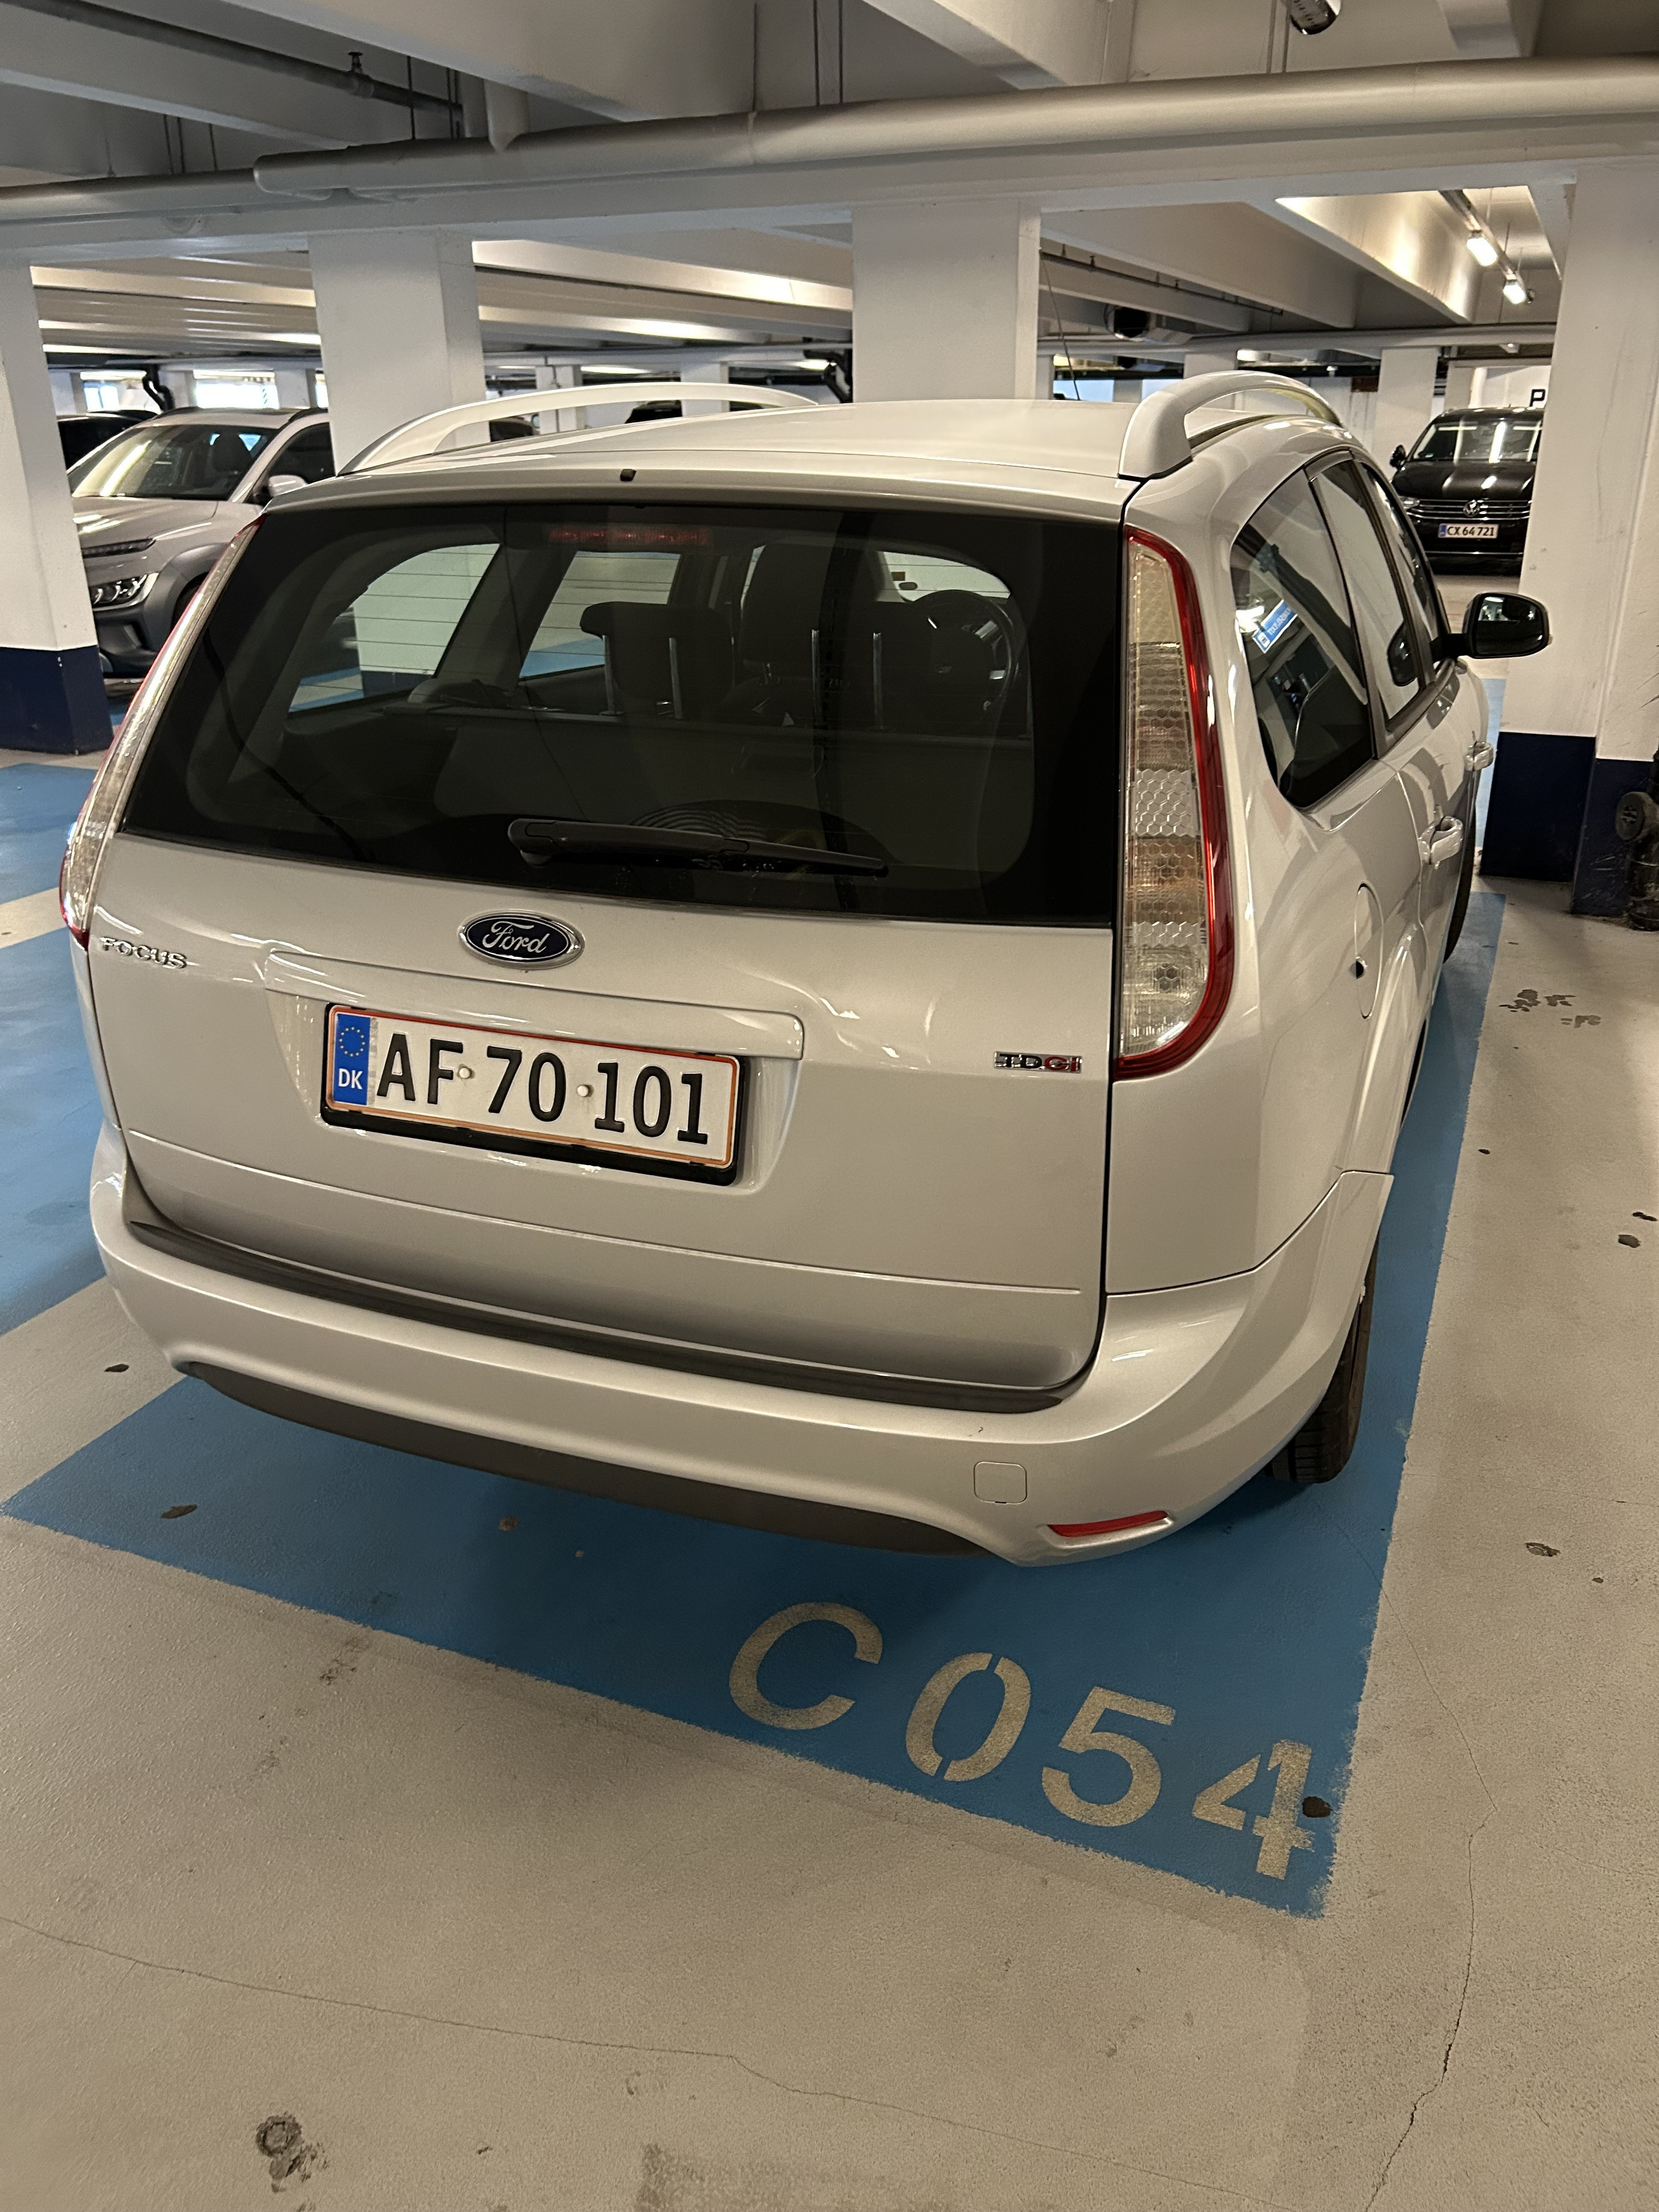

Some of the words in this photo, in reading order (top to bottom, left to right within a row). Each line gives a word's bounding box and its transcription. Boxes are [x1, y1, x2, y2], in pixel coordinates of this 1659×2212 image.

[1447, 526, 1460, 536] CX
[1463, 527, 1475, 536] 64
[1477, 527, 1494, 536] 721
[99, 935, 188, 969] FOCUS
[482, 921, 550, 953] Ford
[338, 1068, 363, 1090] DK
[376, 1032, 464, 1105] AF
[487, 1046, 566, 1122] 70
[594, 1062, 708, 1145] 101
